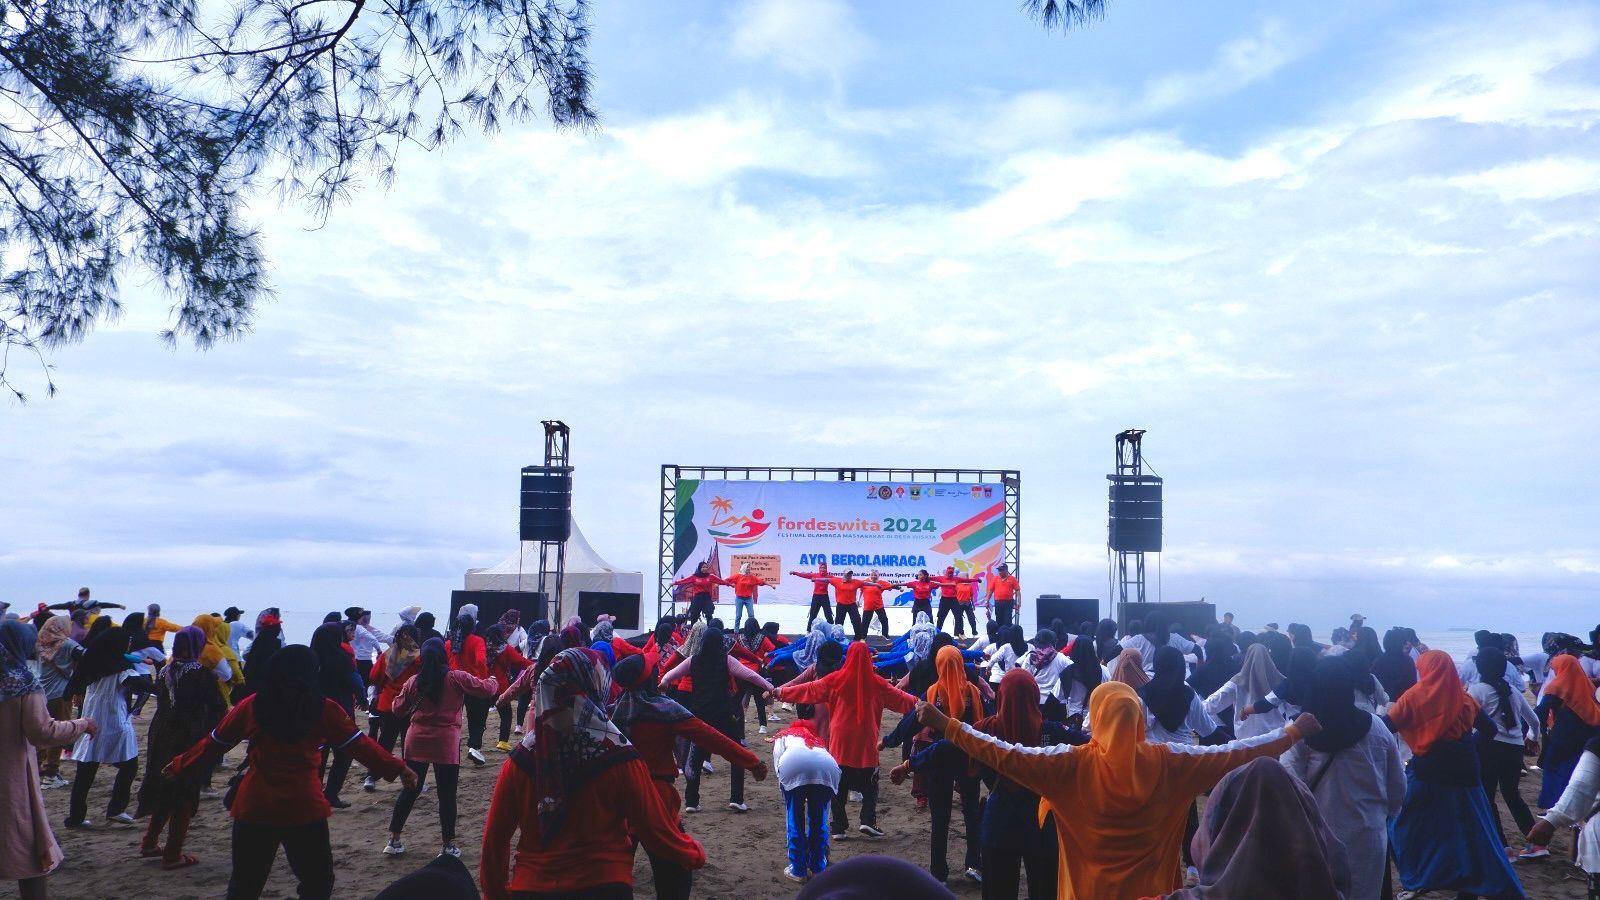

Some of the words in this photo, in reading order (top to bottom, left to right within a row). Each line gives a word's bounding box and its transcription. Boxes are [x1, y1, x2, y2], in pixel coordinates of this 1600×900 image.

[777, 516, 881, 531] fordeswita
[883, 517, 937, 532] 2024
[799, 554, 827, 565] AYO
[831, 554, 926, 567] BEROLAHRAGA
